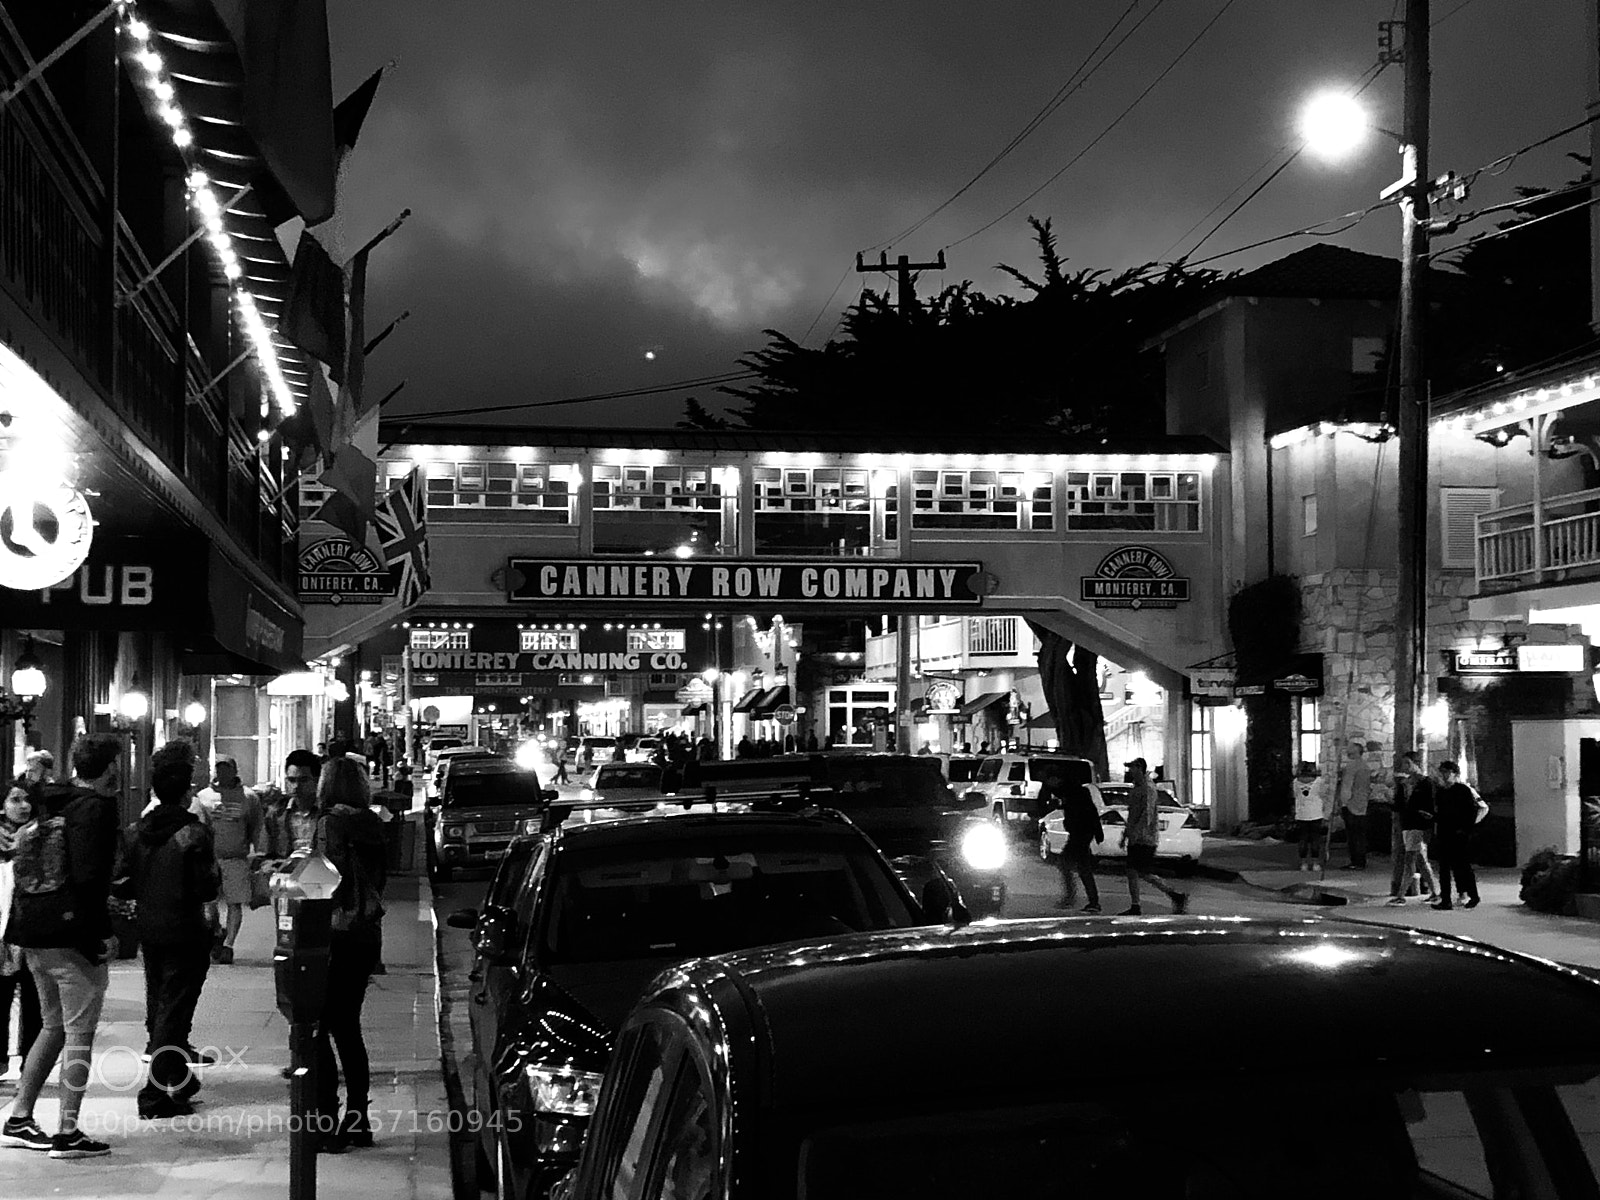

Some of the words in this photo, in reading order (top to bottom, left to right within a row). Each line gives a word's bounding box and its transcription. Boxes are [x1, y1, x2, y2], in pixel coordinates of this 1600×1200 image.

[300, 543, 351, 571] CANNERY
[350, 551, 374, 571] ROW
[1103, 550, 1149, 577] CANNERY
[1147, 556, 1169, 577] ROW
[302, 576, 358, 591] ONTEREY,
[363, 576, 384, 591] CA.
[539, 565, 693, 596] CANNERY
[712, 567, 782, 597] ROW
[801, 568, 957, 598] COMPANY
[1160, 582, 1179, 596] CA.
[532, 652, 641, 670] CANNING
[650, 652, 688, 670] CO.
[507, 686, 553, 695] MONTEREY
